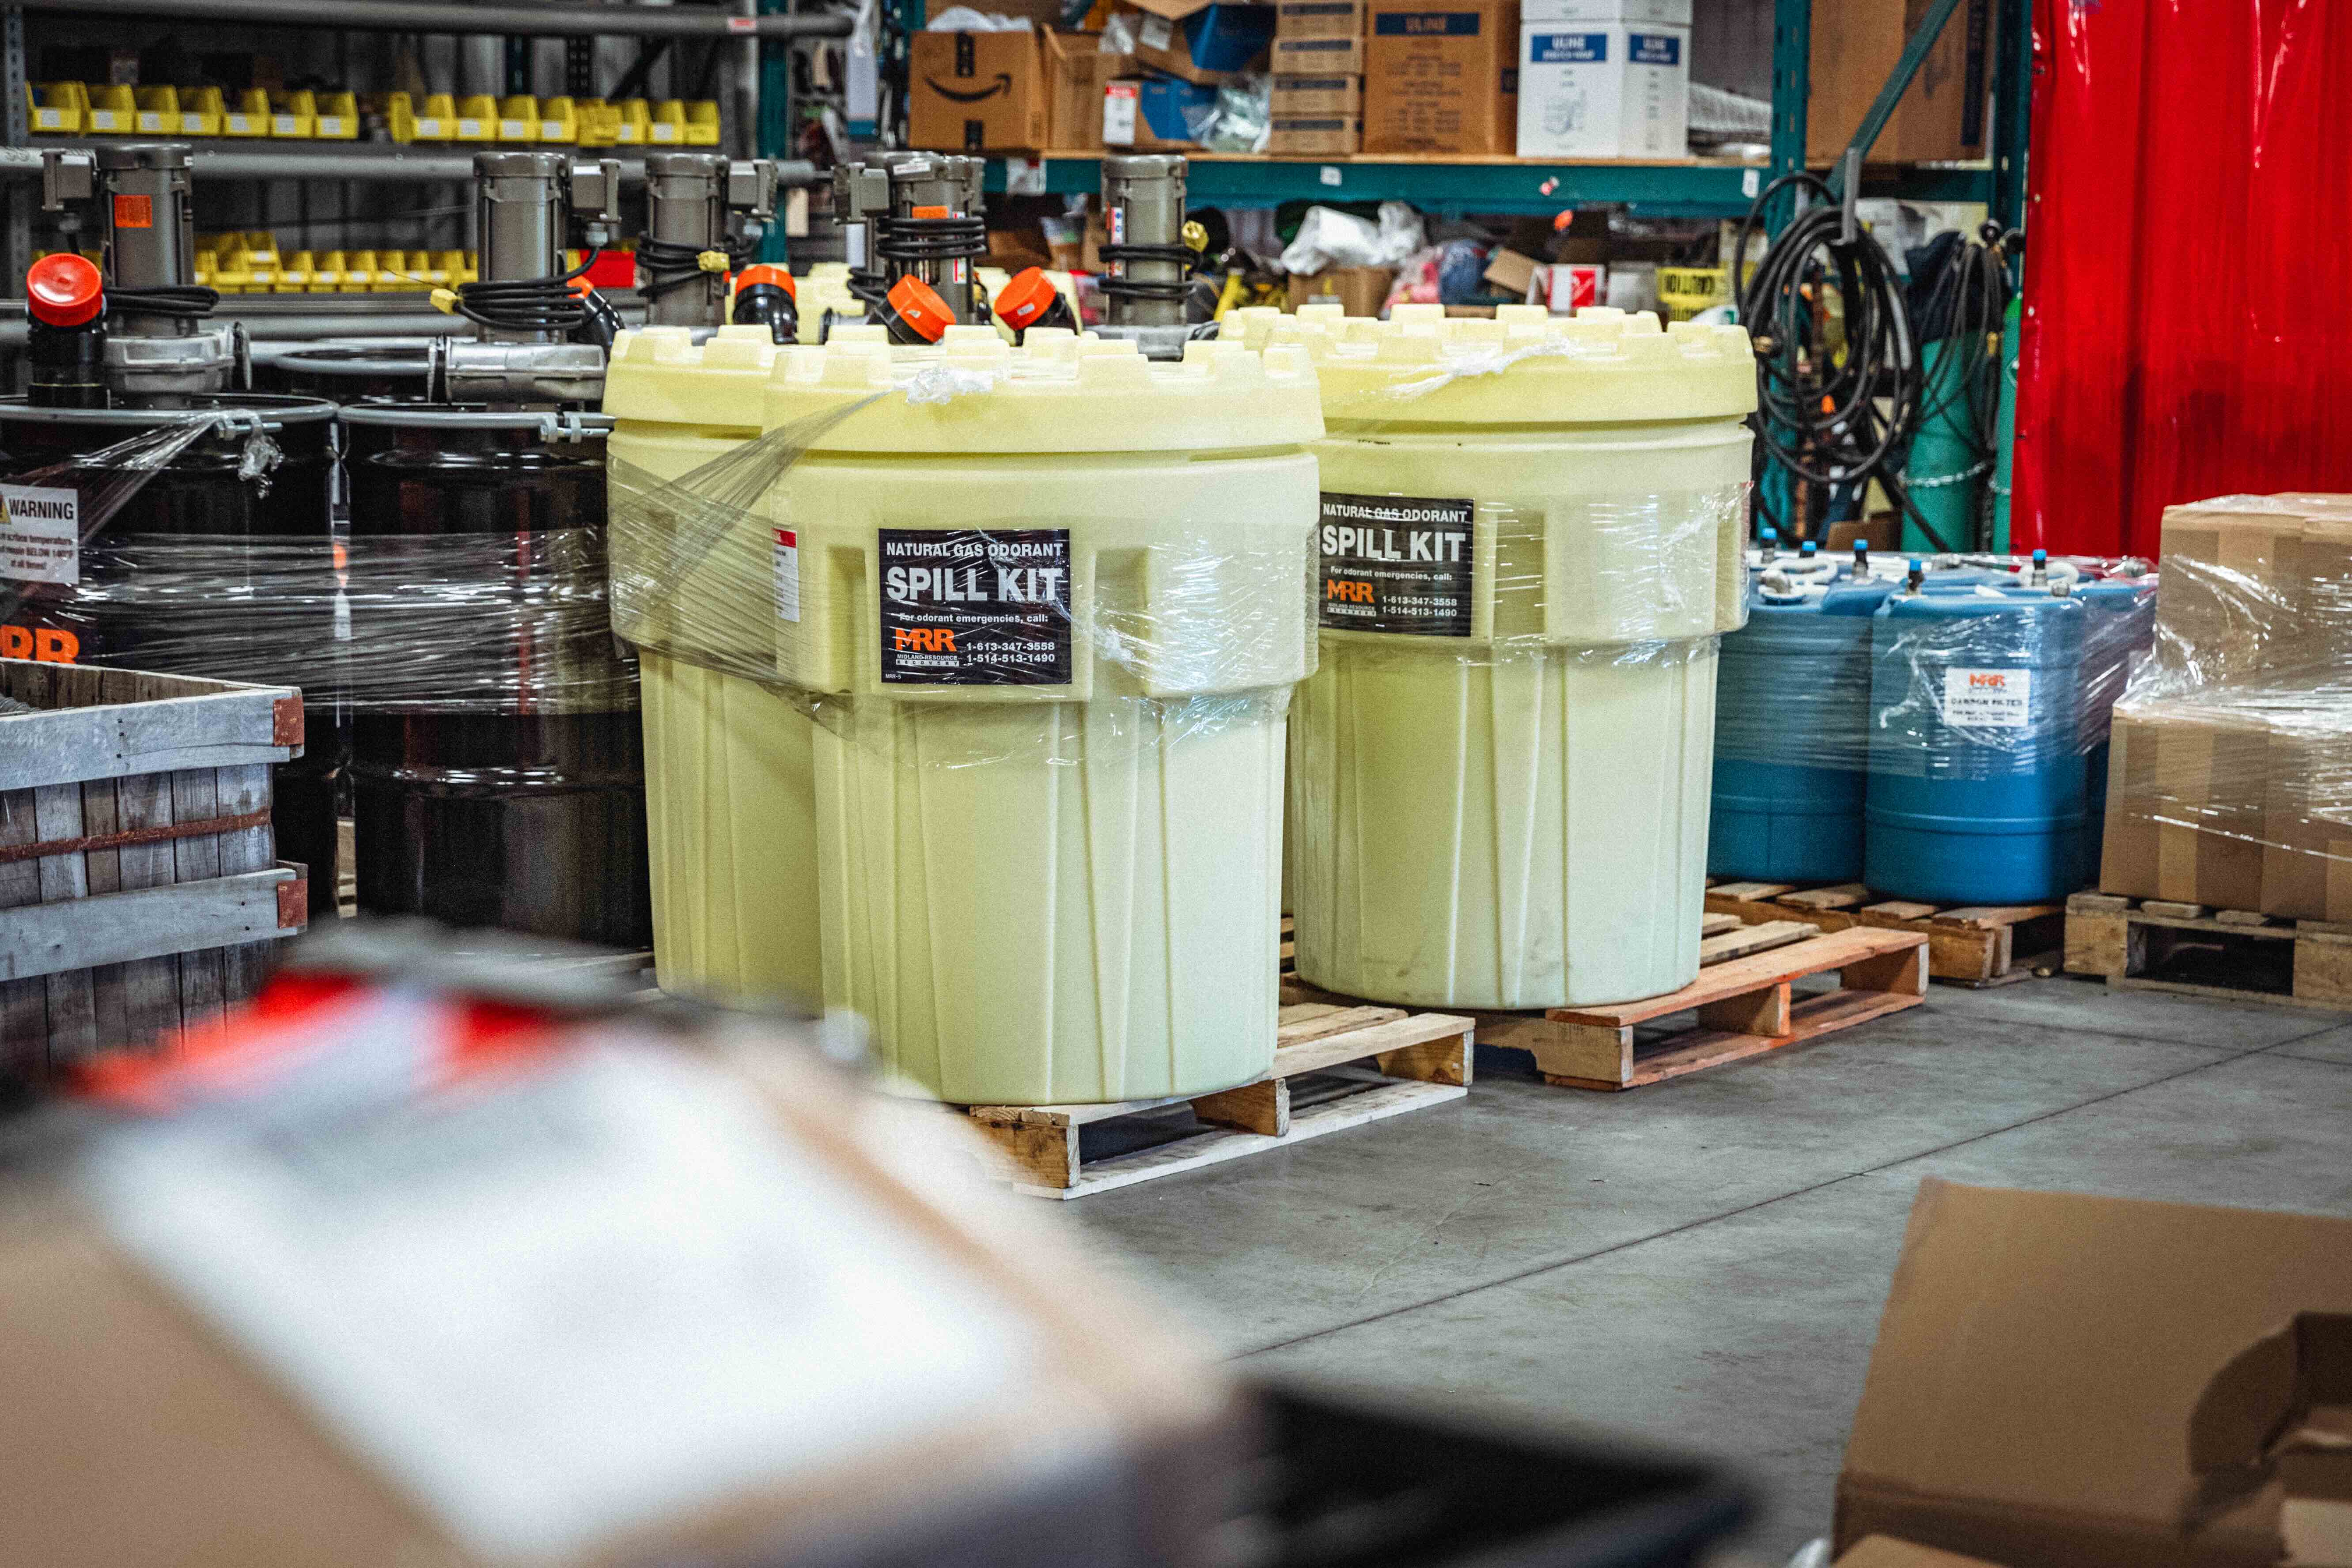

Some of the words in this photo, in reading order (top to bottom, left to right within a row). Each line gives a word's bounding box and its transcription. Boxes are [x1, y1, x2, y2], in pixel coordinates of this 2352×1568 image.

[9, 499, 74, 519] WARNING
[1323, 503, 1369, 518] NATURAL
[1375, 508, 1399, 519] GAS
[1402, 509, 1467, 523] ODORANT
[887, 543, 950, 556] NATURAL
[954, 544, 983, 557] GAS
[988, 543, 1063, 557] ODORANT
[1322, 525, 1401, 560] SPILL
[1410, 531, 1466, 562] KIT
[1343, 568, 1372, 576] odorant
[1375, 571, 1431, 581] emergencies,
[886, 566, 987, 601] SPILL
[998, 568, 1063, 601] KIT
[1327, 579, 1375, 603] MRR
[1382, 596, 1457, 606] 1-613-347-3558
[1382, 606, 1457, 617] 1-514-513-1490
[956, 614, 1024, 624] emergencies,
[896, 629, 957, 651] MRR
[966, 642, 1055, 651] 1-613-347-3558
[966, 654, 1055, 663] 1-514-513-1490
[1969, 673, 2005, 686] MRR
